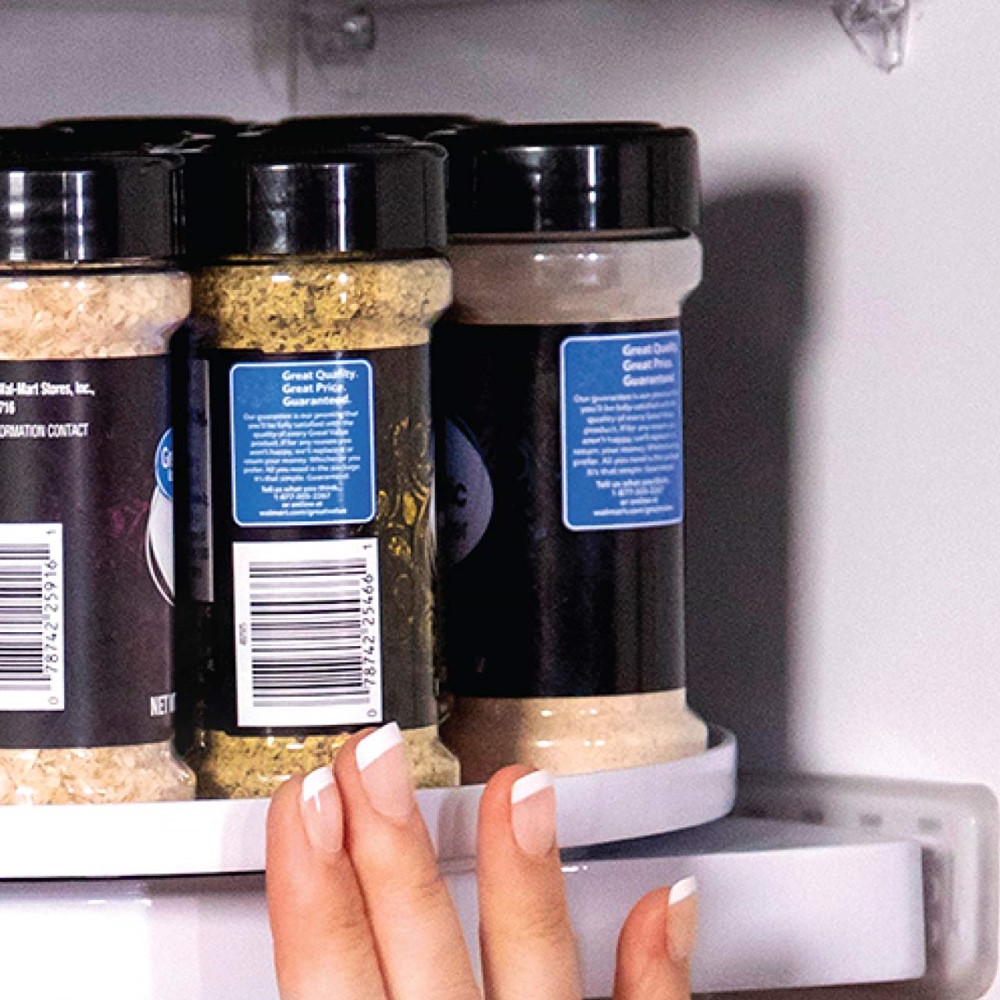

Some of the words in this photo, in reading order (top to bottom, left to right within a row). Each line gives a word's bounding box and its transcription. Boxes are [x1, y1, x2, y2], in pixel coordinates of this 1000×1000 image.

[281, 370, 313, 381] Great
[281, 382, 314, 394] Great
[362, 574, 375, 625] 25466
[362, 635, 376, 686] 78742
